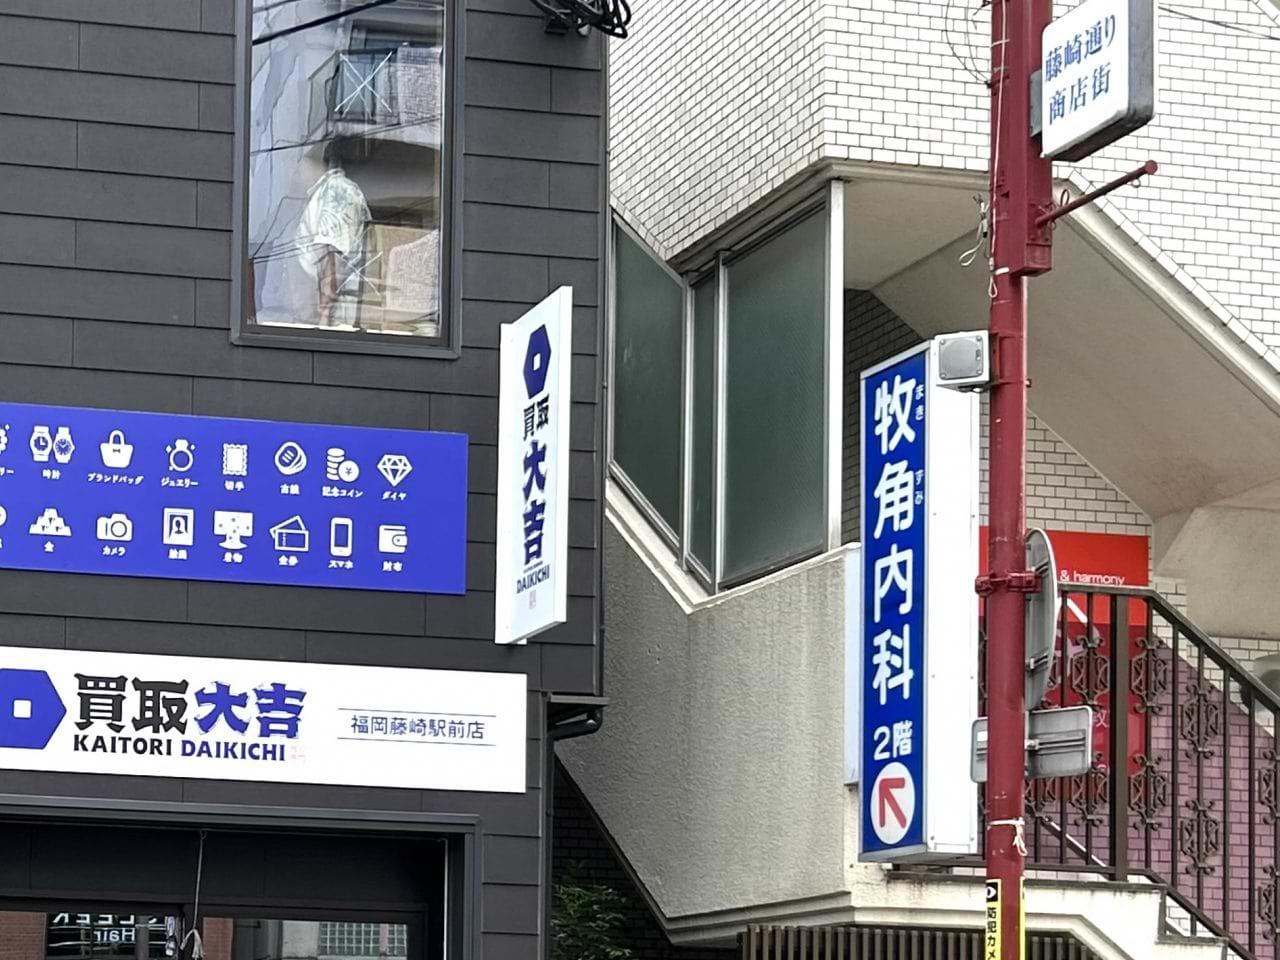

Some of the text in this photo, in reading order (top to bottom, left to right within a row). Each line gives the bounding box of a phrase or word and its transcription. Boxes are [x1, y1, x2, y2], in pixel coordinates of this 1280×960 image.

[1045, 14, 1116, 82] 藤崎通り
[1049, 63, 1111, 125] 商店街
[87, 472, 144, 485] ブランドバッグ
[161, 476, 199, 488] ジュエリー
[322, 486, 363, 498] 記念コイン
[382, 491, 407, 501] ダイヤ
[873, 374, 916, 706] 牧角内科
[102, 545, 126, 557] カメラ
[328, 559, 354, 569] スマホ
[516, 564, 550, 594] DAIKICHI
[1073, 571, 1125, 585] harmony
[73, 673, 307, 739] 買取大吉
[350, 714, 486, 739] 福岡藤崎駅前店
[873, 719, 913, 760] 2階
[73, 736, 173, 756] KAITORI
[180, 740, 286, 762] DAIKICHI
